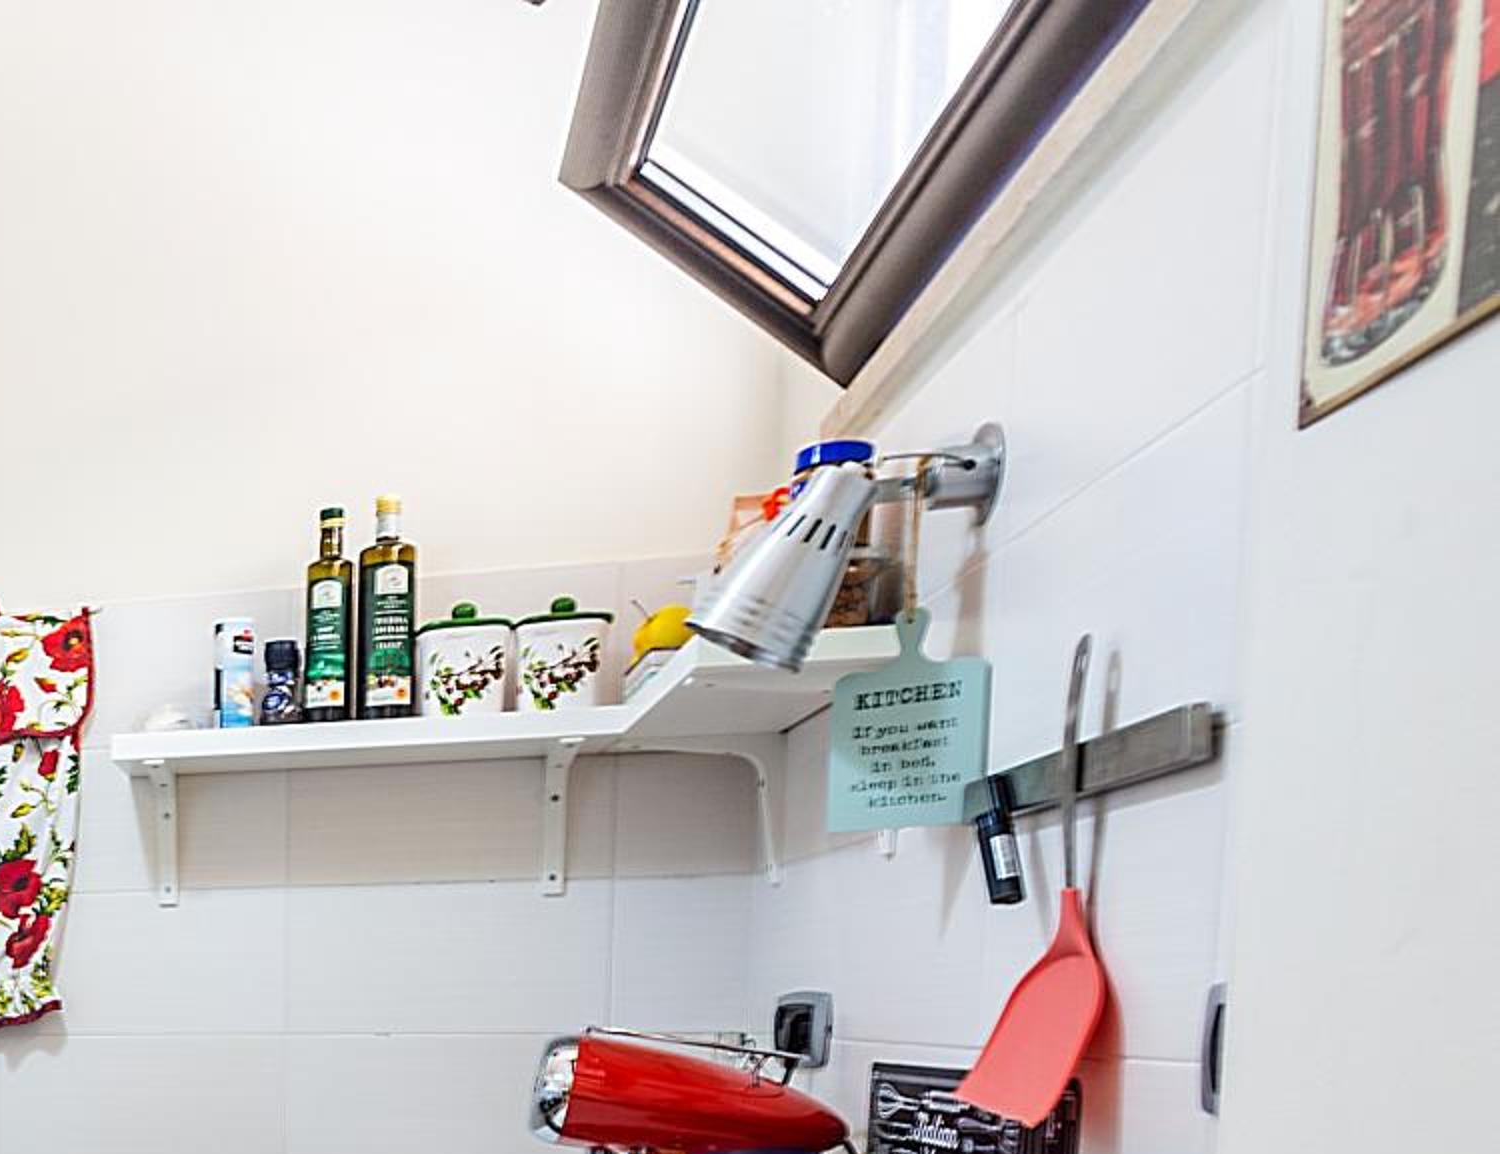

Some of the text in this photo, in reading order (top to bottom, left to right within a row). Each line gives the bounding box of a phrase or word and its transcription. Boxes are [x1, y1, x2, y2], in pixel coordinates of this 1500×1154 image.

[854, 680, 962, 710] KITCHEN
[852, 717, 958, 740] If you want
[861, 736, 948, 755] breakfast
[872, 761, 891, 773] in
[902, 775, 923, 787] in
[932, 772, 961, 784] the
